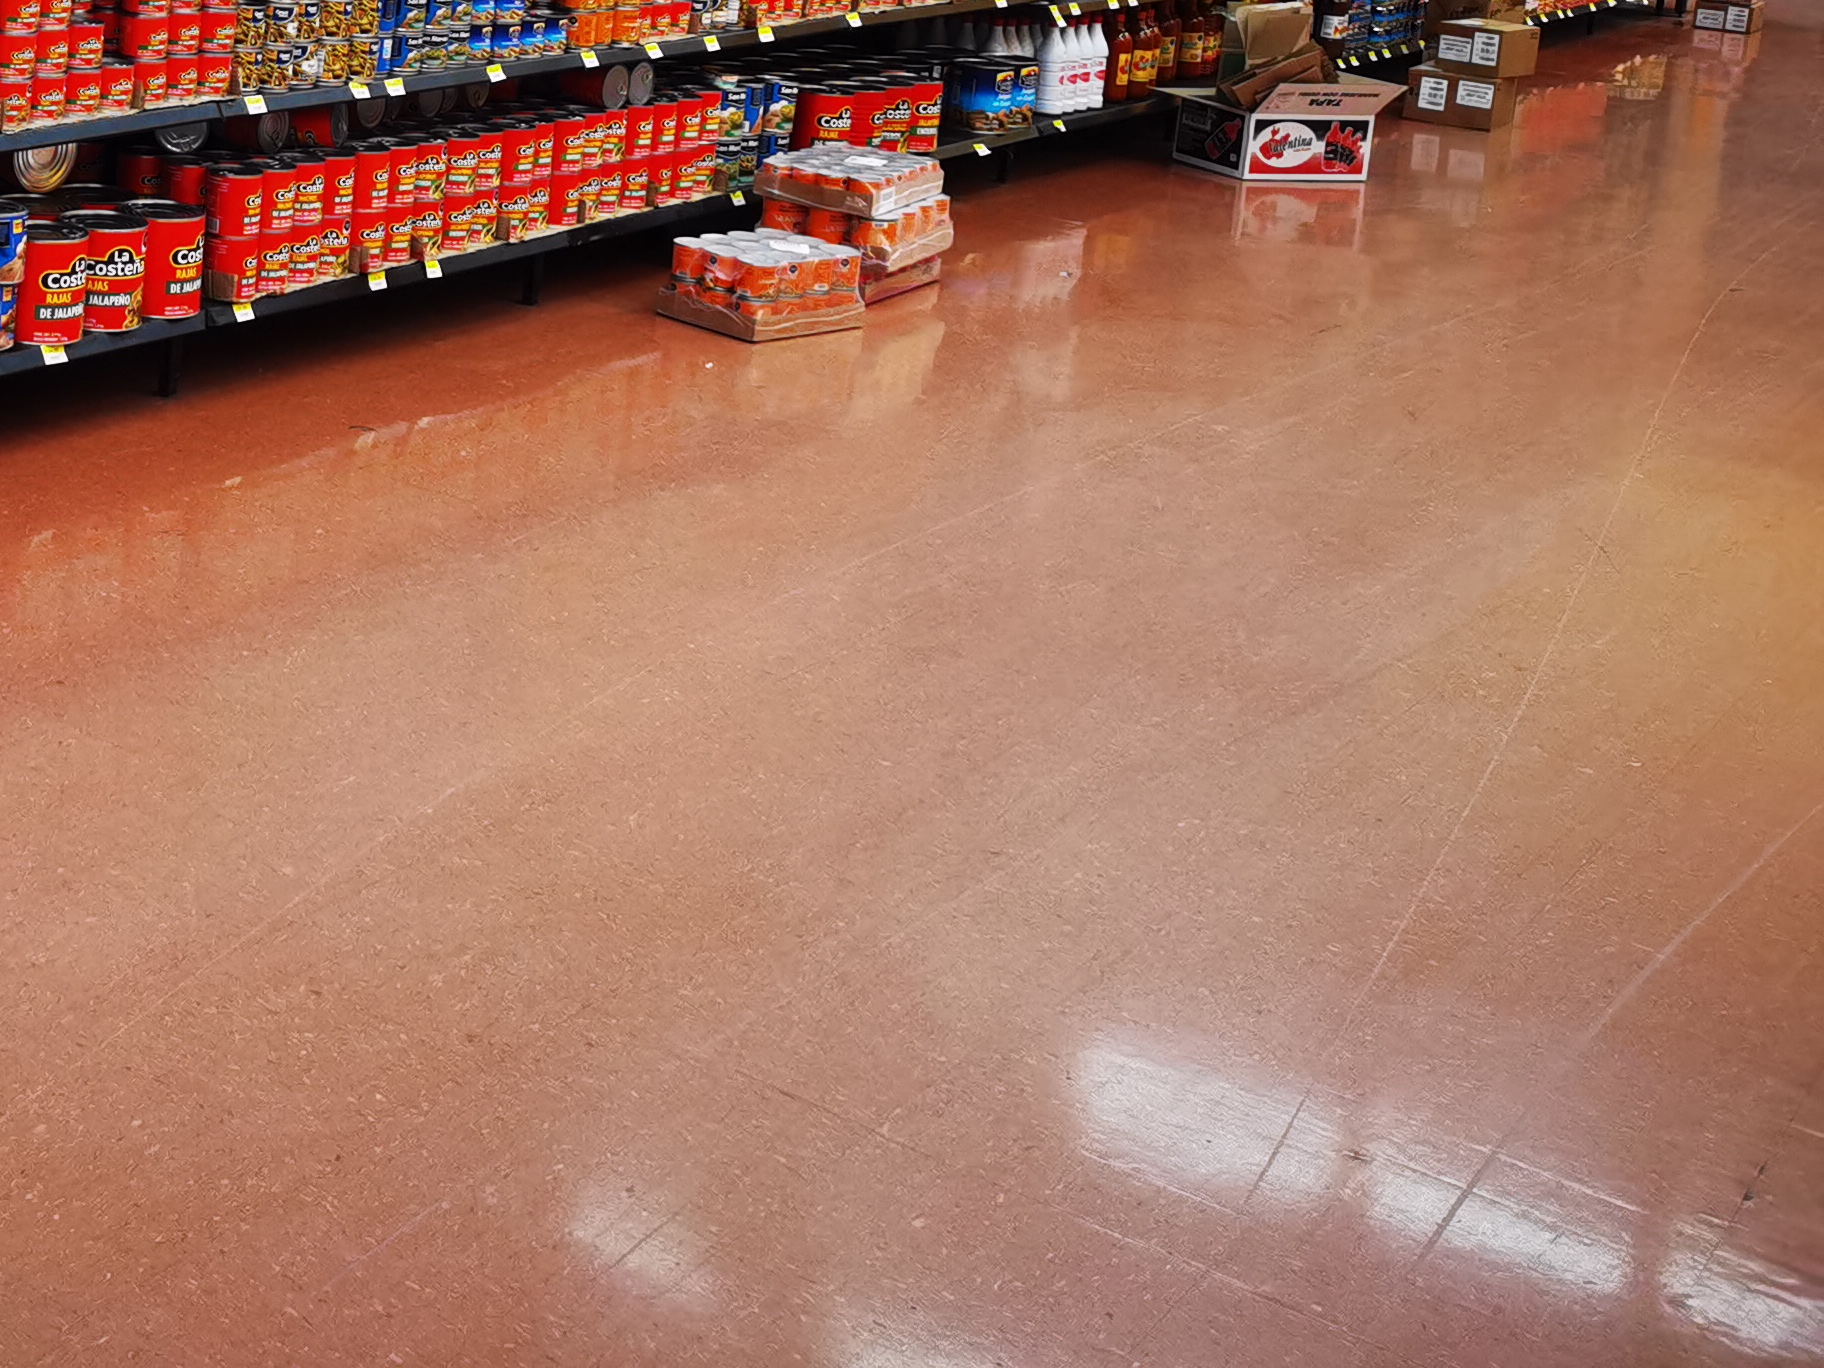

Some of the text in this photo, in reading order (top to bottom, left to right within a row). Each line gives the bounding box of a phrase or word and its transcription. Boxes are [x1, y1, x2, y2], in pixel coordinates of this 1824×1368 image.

[114, 251, 129, 262] La
[86, 257, 144, 275] Costeña
[176, 269, 196, 278] RAJAS
[87, 282, 108, 290] AJAS
[171, 283, 181, 293] DE
[46, 294, 71, 303] RAJAS
[89, 292, 130, 306] JALAPEÑO
[40, 308, 52, 319] DE
